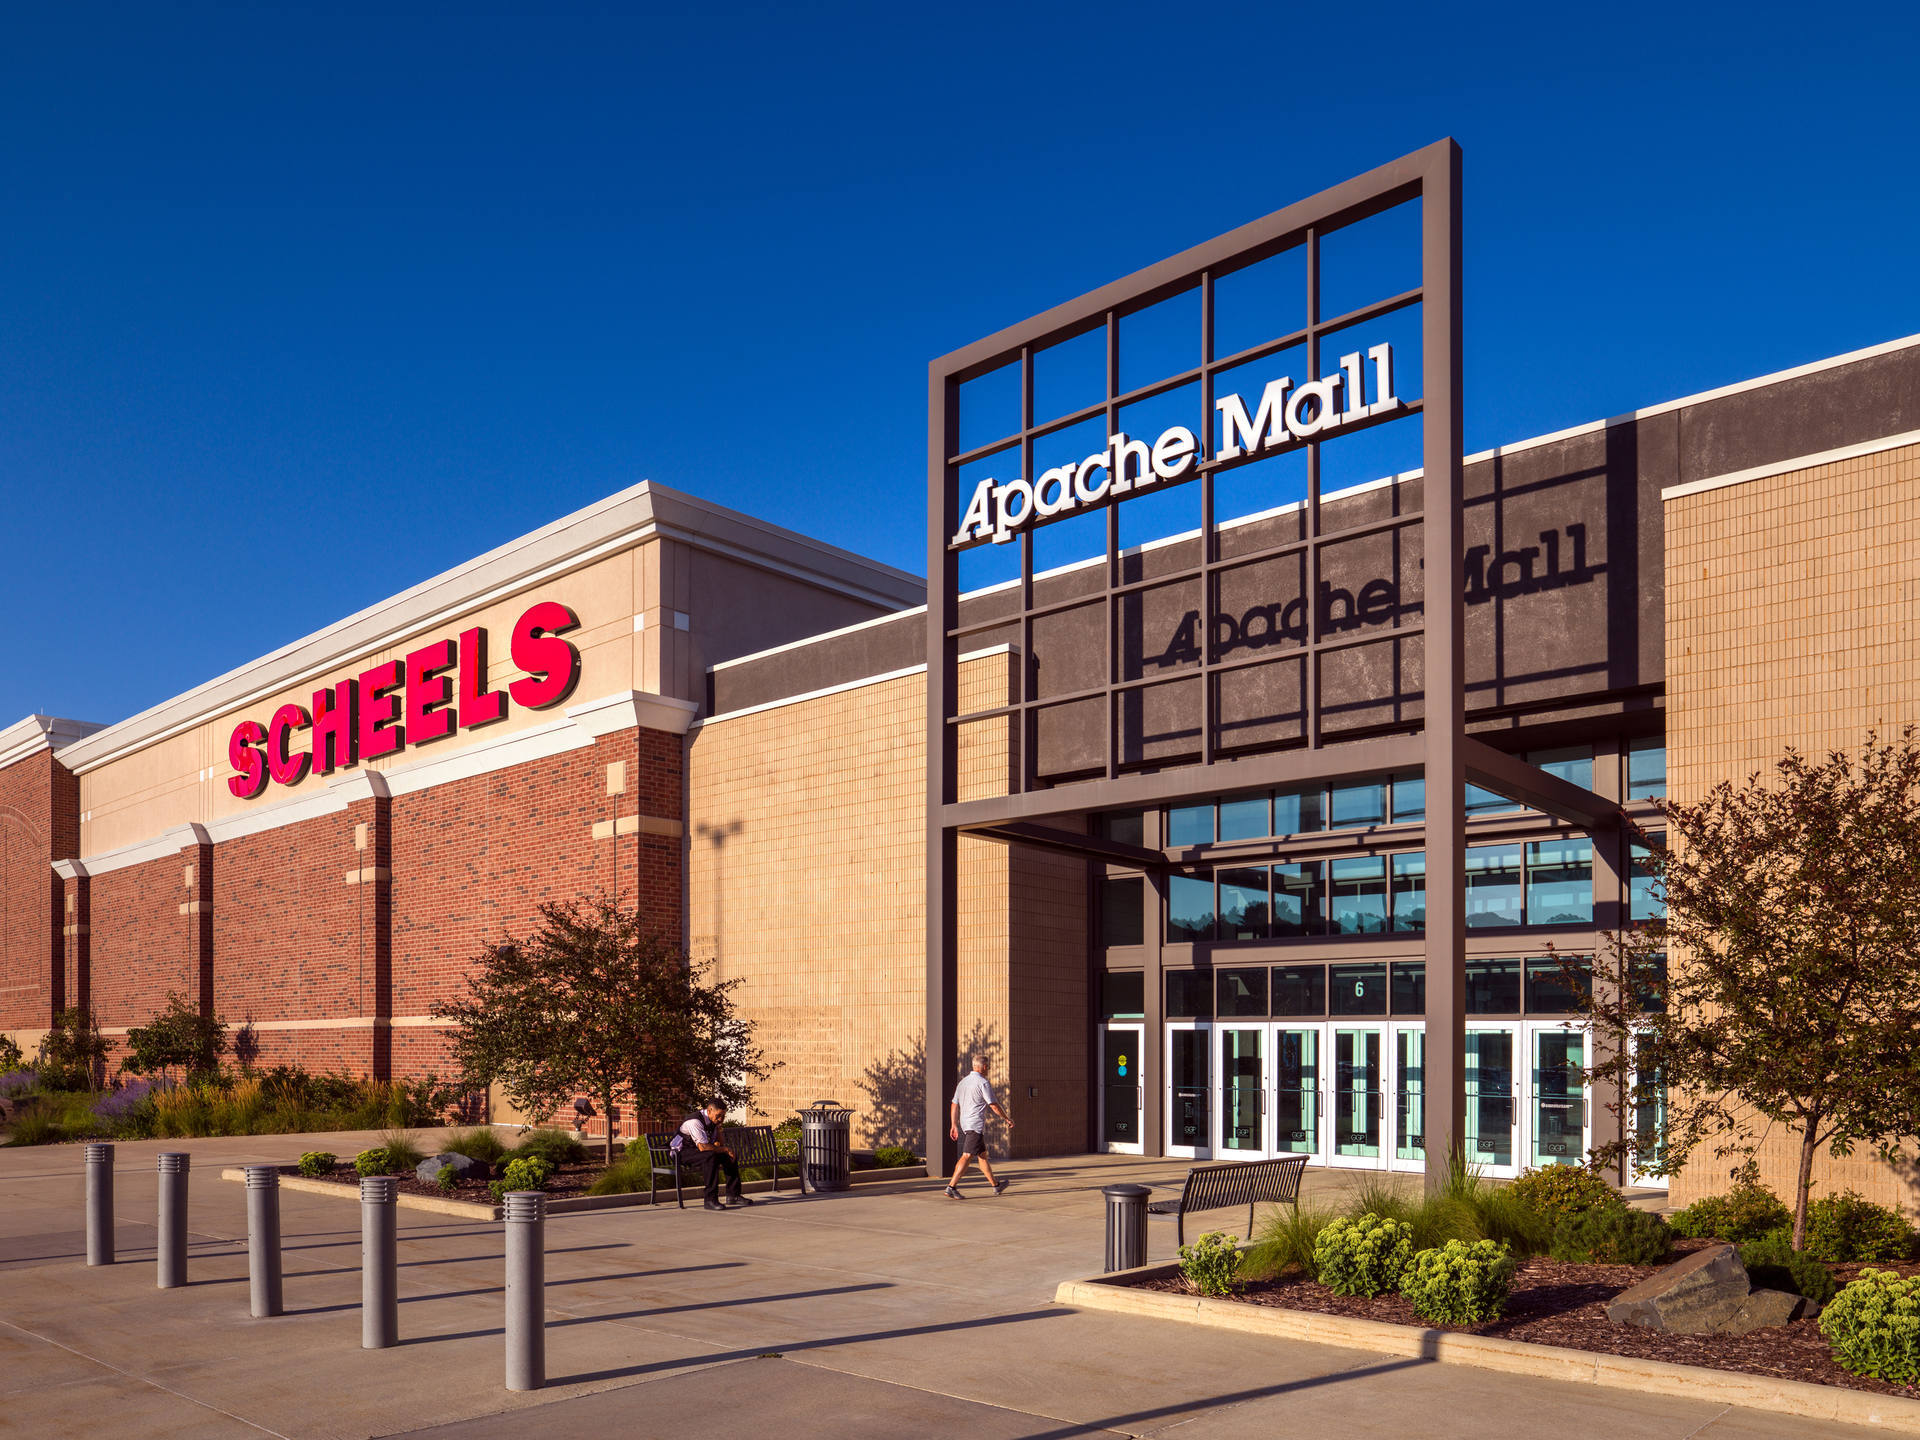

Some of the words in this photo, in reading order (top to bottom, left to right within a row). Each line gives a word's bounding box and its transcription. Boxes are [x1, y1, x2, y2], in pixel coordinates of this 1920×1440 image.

[952, 426, 1200, 545] Apache
[1215, 342, 1402, 463] Mall
[228, 601, 582, 800] SCHEELS
[1355, 981, 1364, 997] 6
